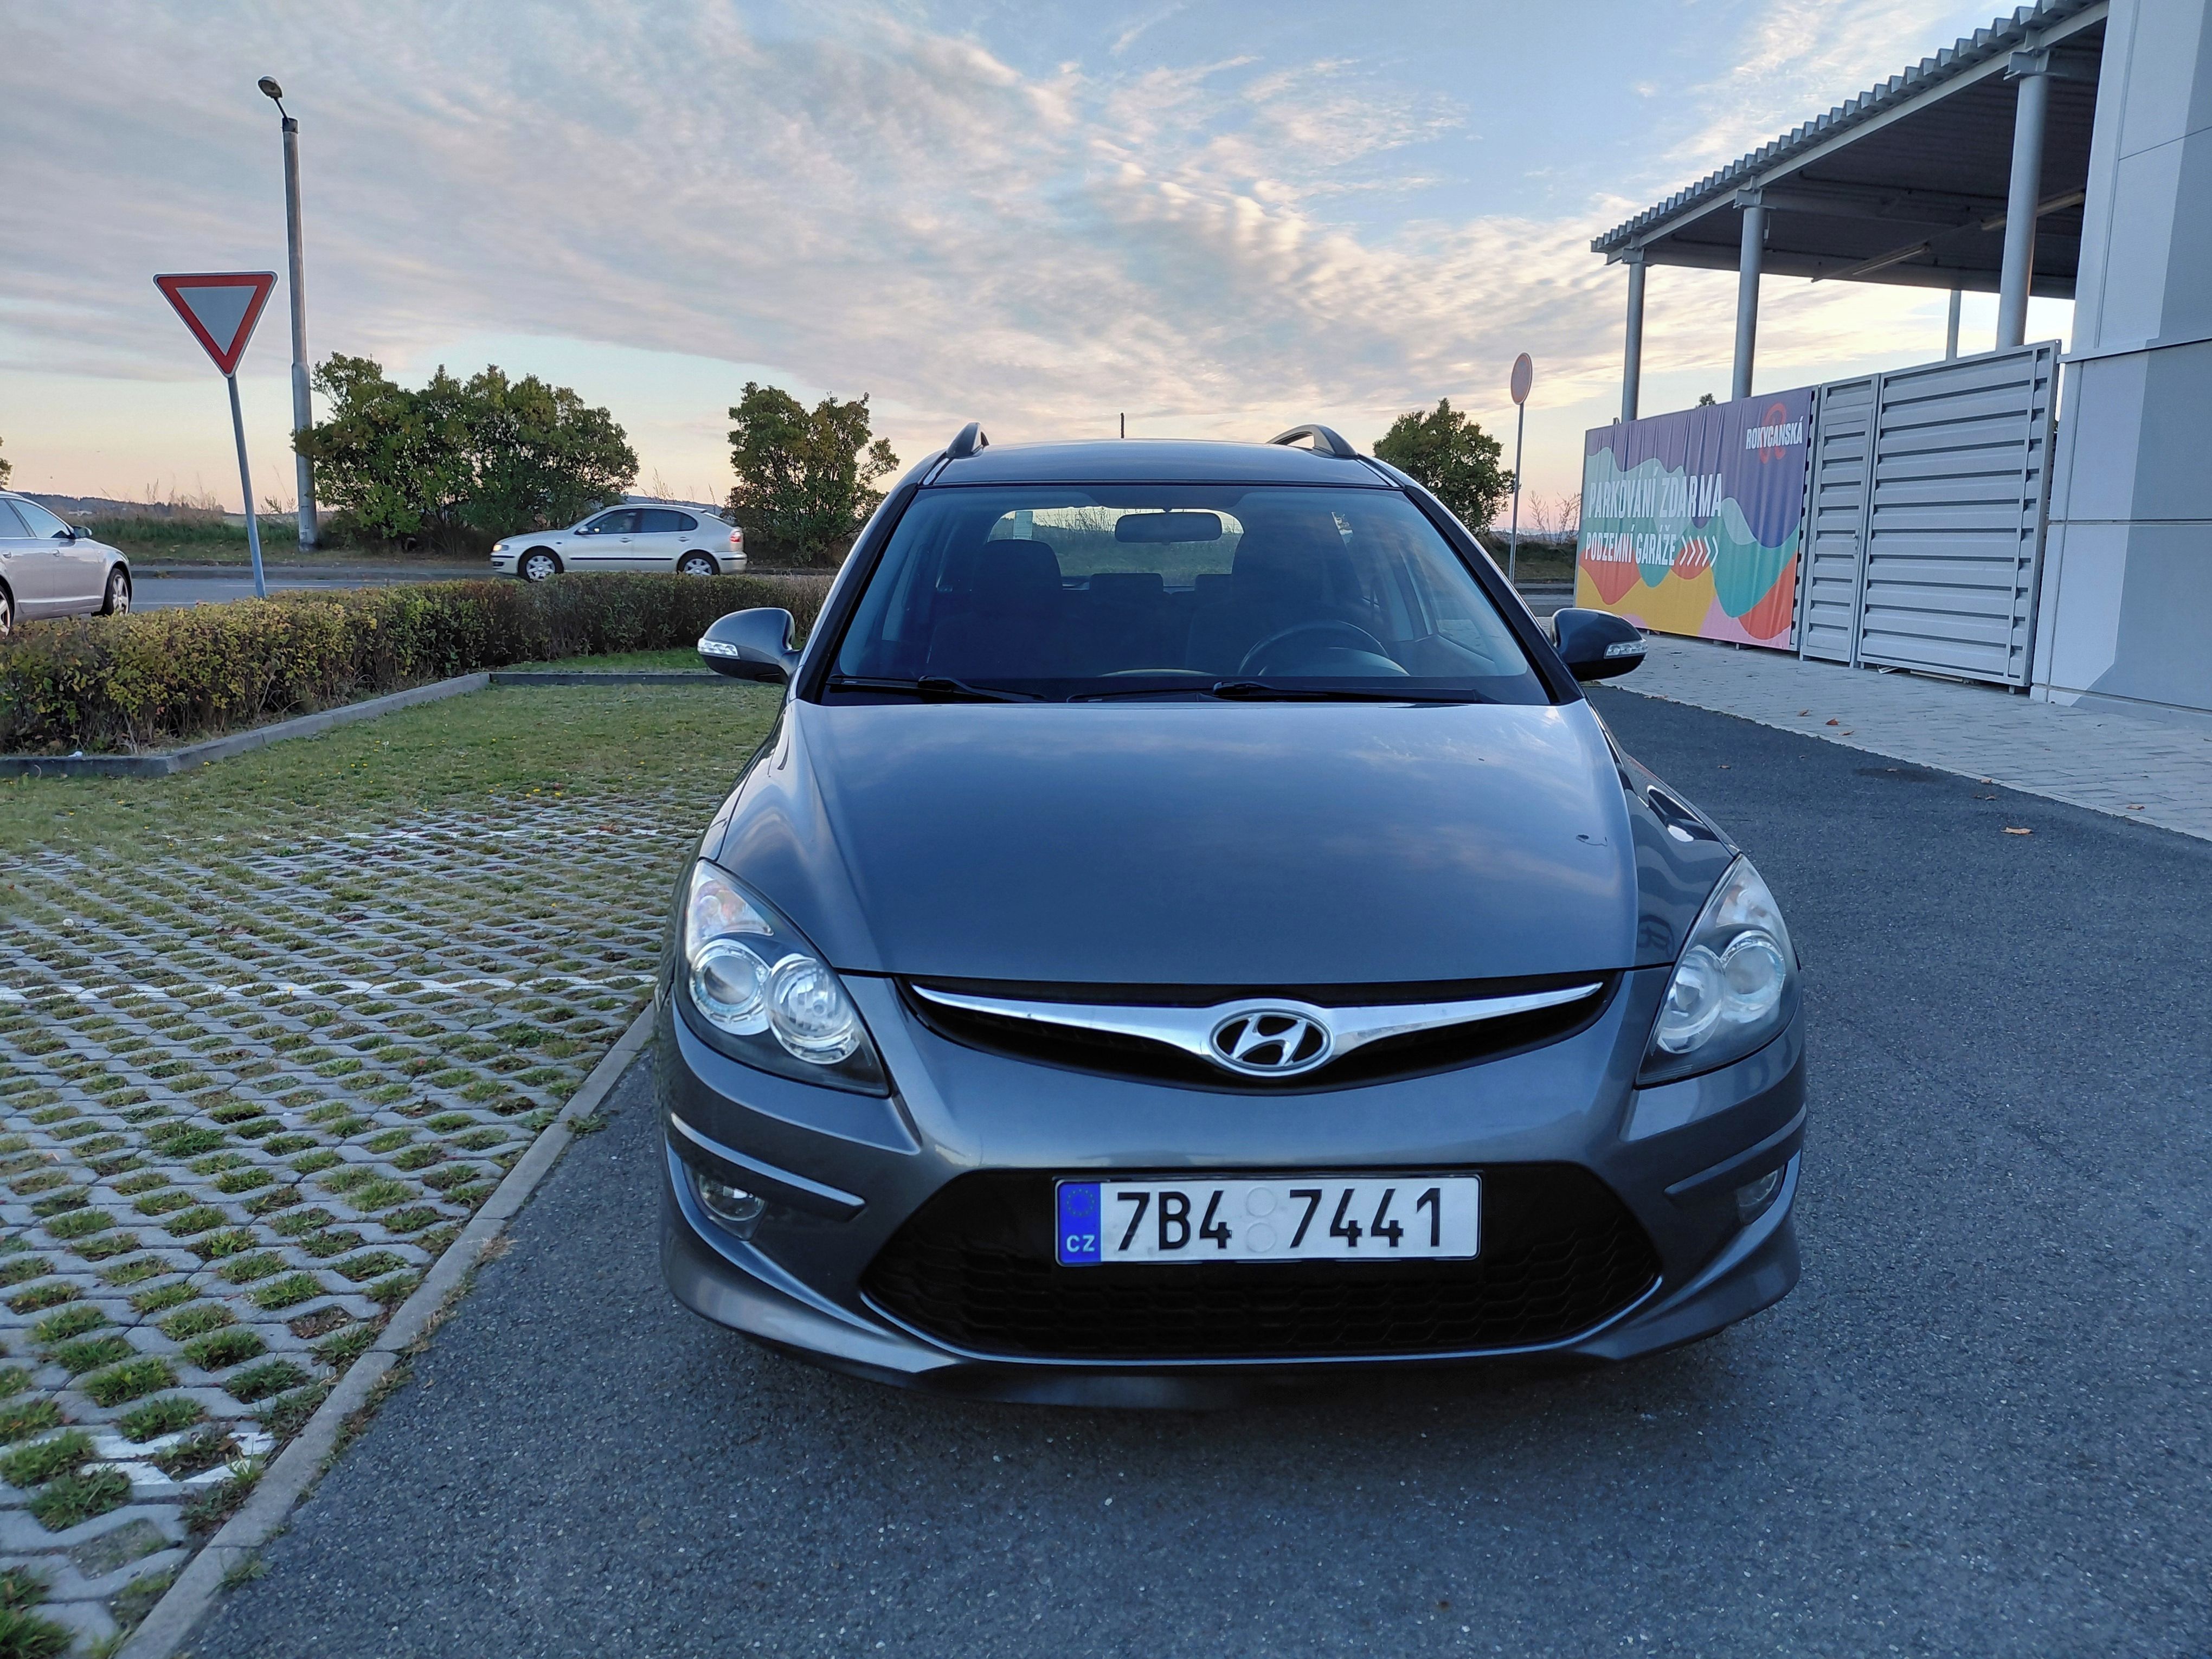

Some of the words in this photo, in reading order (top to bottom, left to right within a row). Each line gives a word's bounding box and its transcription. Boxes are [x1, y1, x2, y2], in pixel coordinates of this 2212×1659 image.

[1746, 416, 1803, 449] ROKYCANSKÁ
[1589, 467, 1658, 518] PARKOVÁNÍ
[1660, 473, 1721, 518] ZDARMA
[1585, 524, 1635, 563] PODZEMNÍ
[1635, 525, 1676, 565] GARÁŽE
[1117, 1190, 1232, 1251] 7B4
[1289, 1187, 1442, 1249] 7441
[1066, 1235, 1096, 1253] CZ
